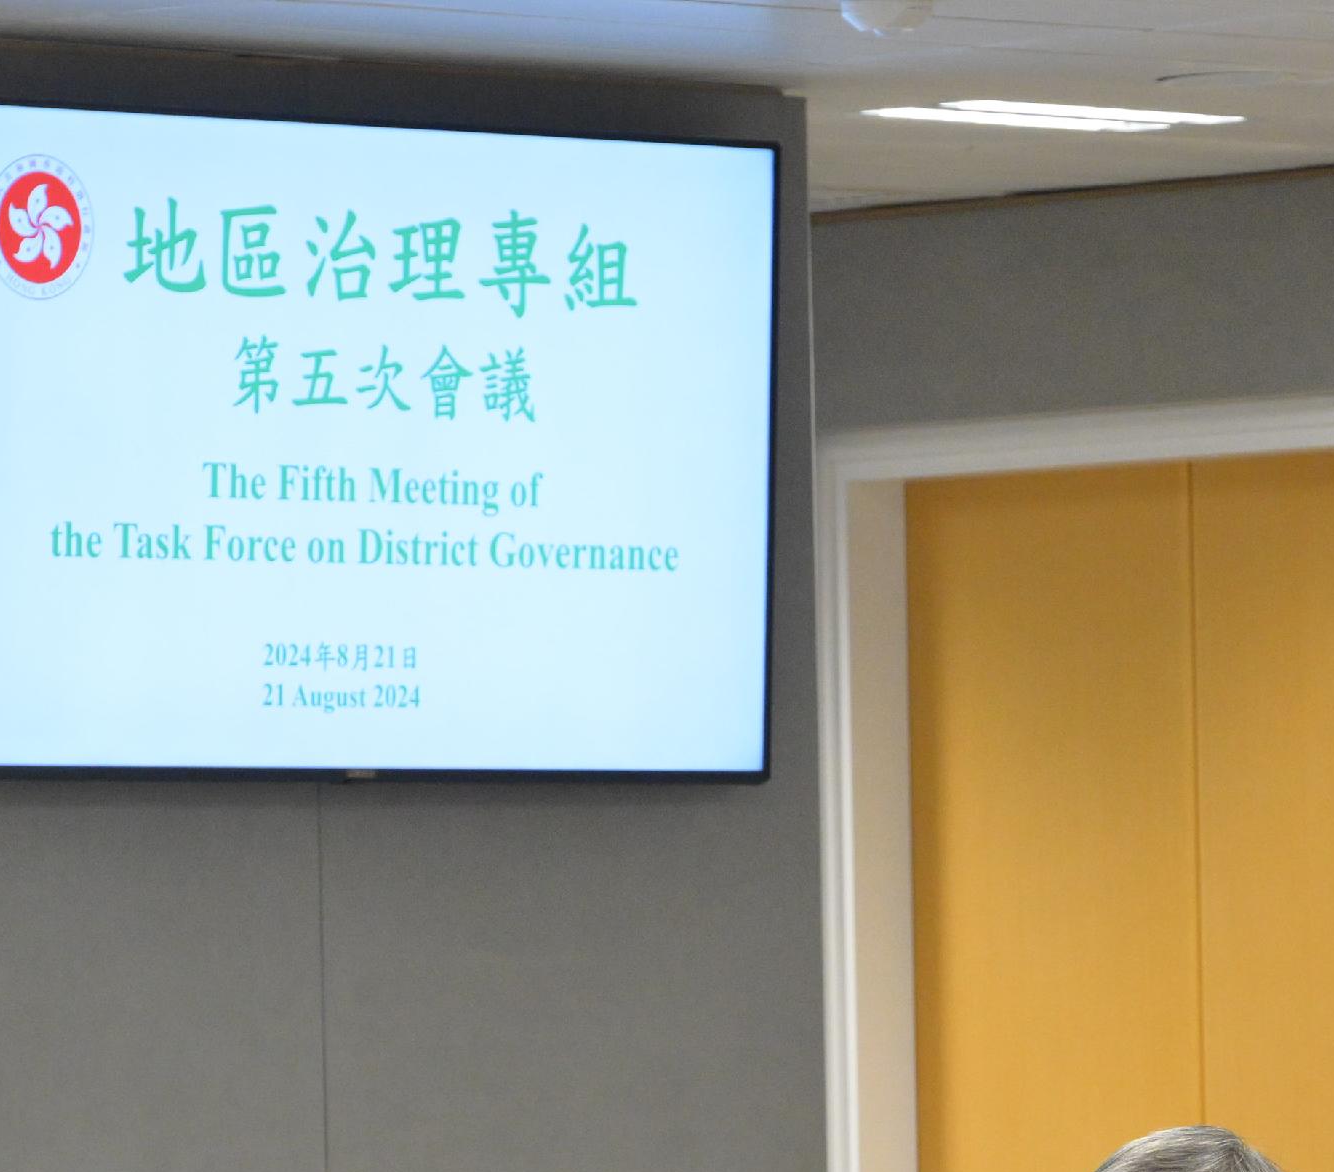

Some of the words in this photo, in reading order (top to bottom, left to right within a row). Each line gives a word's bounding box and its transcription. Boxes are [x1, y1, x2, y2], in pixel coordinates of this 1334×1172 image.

[120, 193, 640, 321] 地區治理專組
[230, 332, 538, 425] 第五次會議
[200, 459, 268, 502] The
[275, 461, 358, 504] Fifth
[367, 464, 502, 518] Meeting
[507, 469, 546, 509] of
[48, 518, 105, 560] the
[110, 520, 193, 562] Task
[202, 522, 298, 564] Force
[305, 535, 348, 566] on
[356, 525, 480, 569] District
[486, 529, 681, 574] Governance
[261, 640, 418, 673] 2024年8月21日
[260, 680, 285, 708] 21
[290, 682, 368, 715] August
[371, 681, 422, 710] 2024
